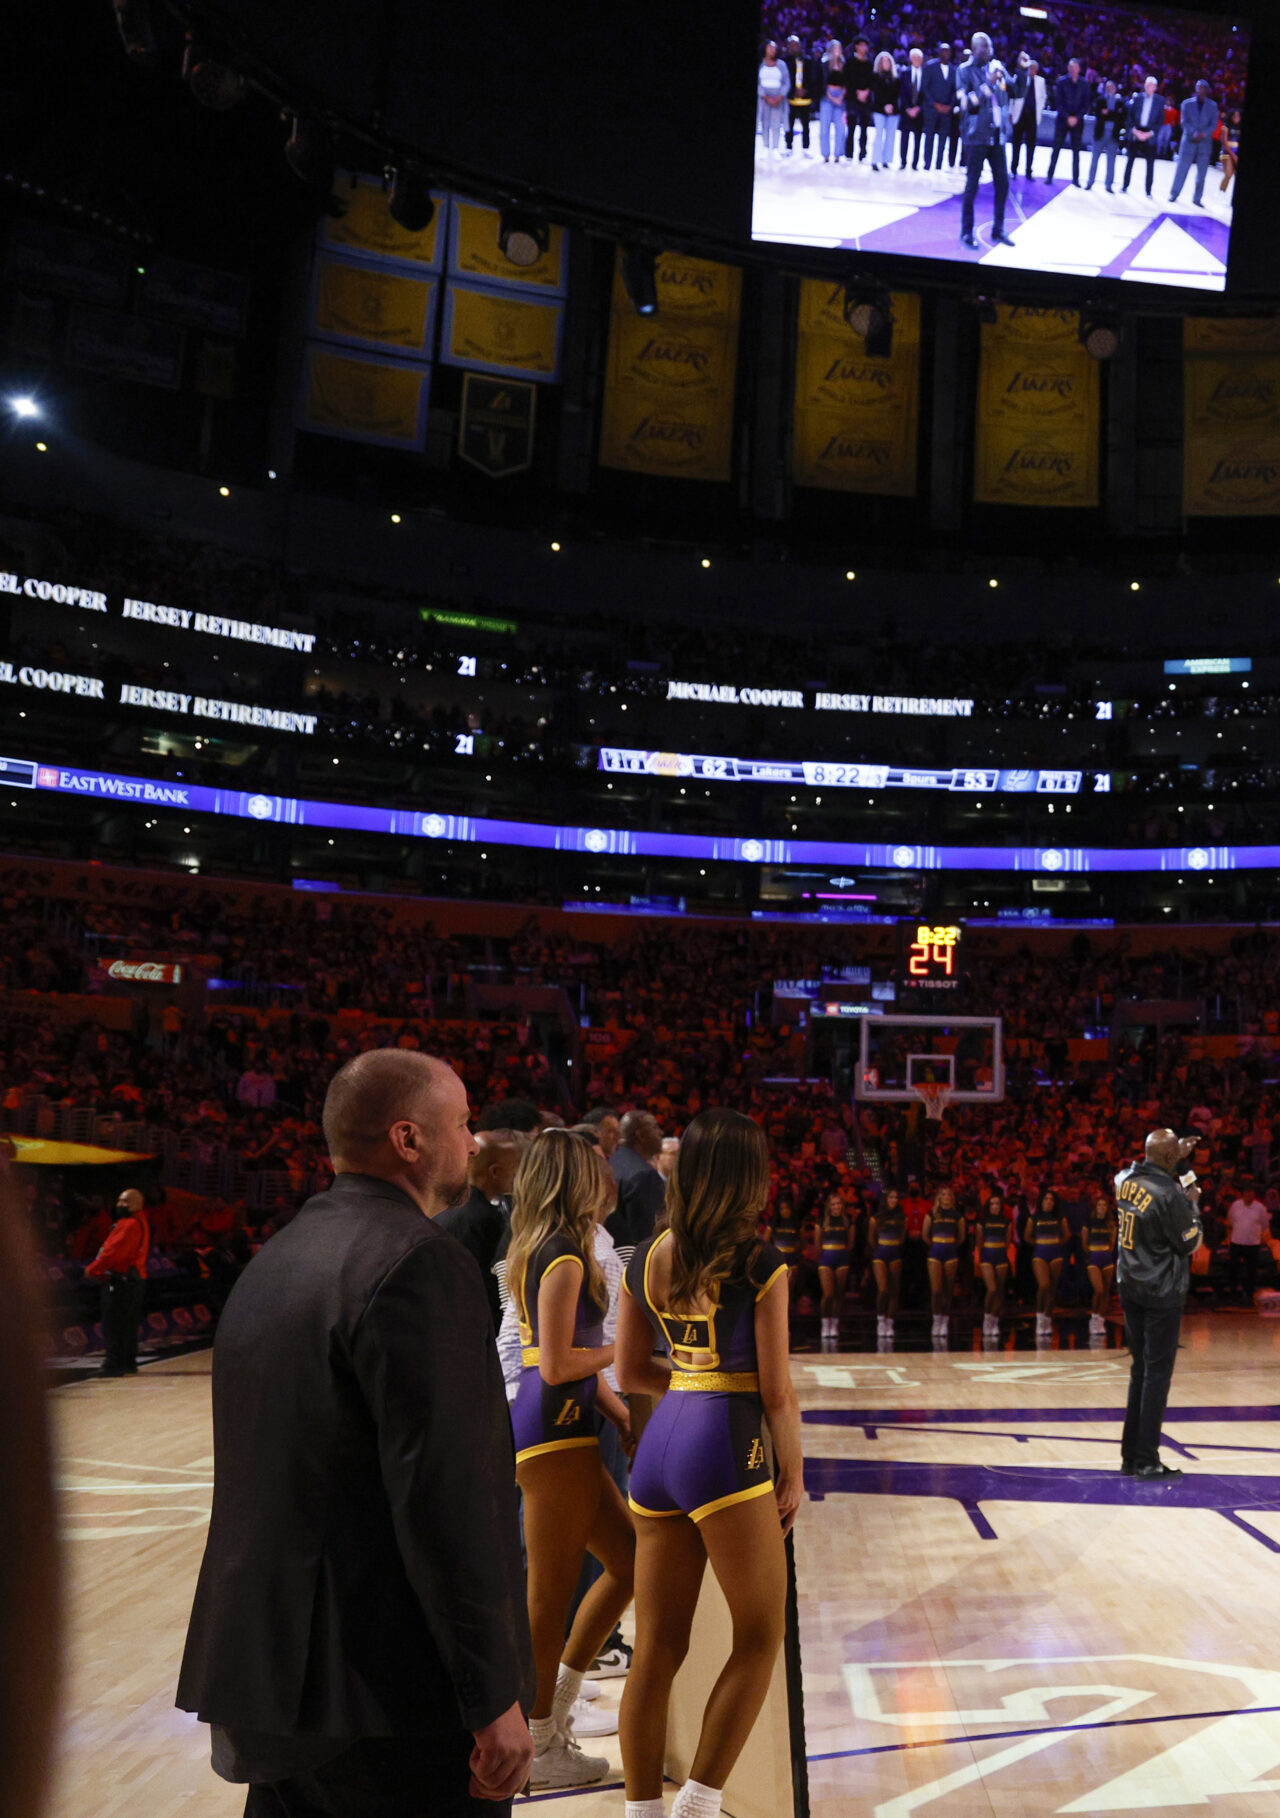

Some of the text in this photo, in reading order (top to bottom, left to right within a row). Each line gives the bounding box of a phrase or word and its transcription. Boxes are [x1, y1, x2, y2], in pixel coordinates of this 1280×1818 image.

[23, 579, 108, 613] COOPER
[122, 598, 194, 629] JERSEY
[194, 613, 317, 653] RETIREMENT
[457, 655, 477, 677] 21
[18, 667, 104, 699] COOPER
[120, 684, 192, 714] JERSEY
[192, 696, 318, 735] RETIREMENT
[667, 681, 975, 717] MICHAEL COOPER JERSEY RETIREMENT
[1095, 701, 1113, 720] 21
[454, 733, 475, 756] 21
[701, 758, 728, 776] 62
[751, 765, 793, 778] Lakers
[813, 766, 860, 784] 8:22
[902, 772, 938, 785] Spurs
[963, 772, 988, 788] 53
[1093, 773, 1111, 793] 21
[917, 926, 957, 945] 8:22
[910, 943, 952, 975] 24
[918, 980, 958, 989] TISSOT
[840, 1005, 869, 1014] TOYOTA
